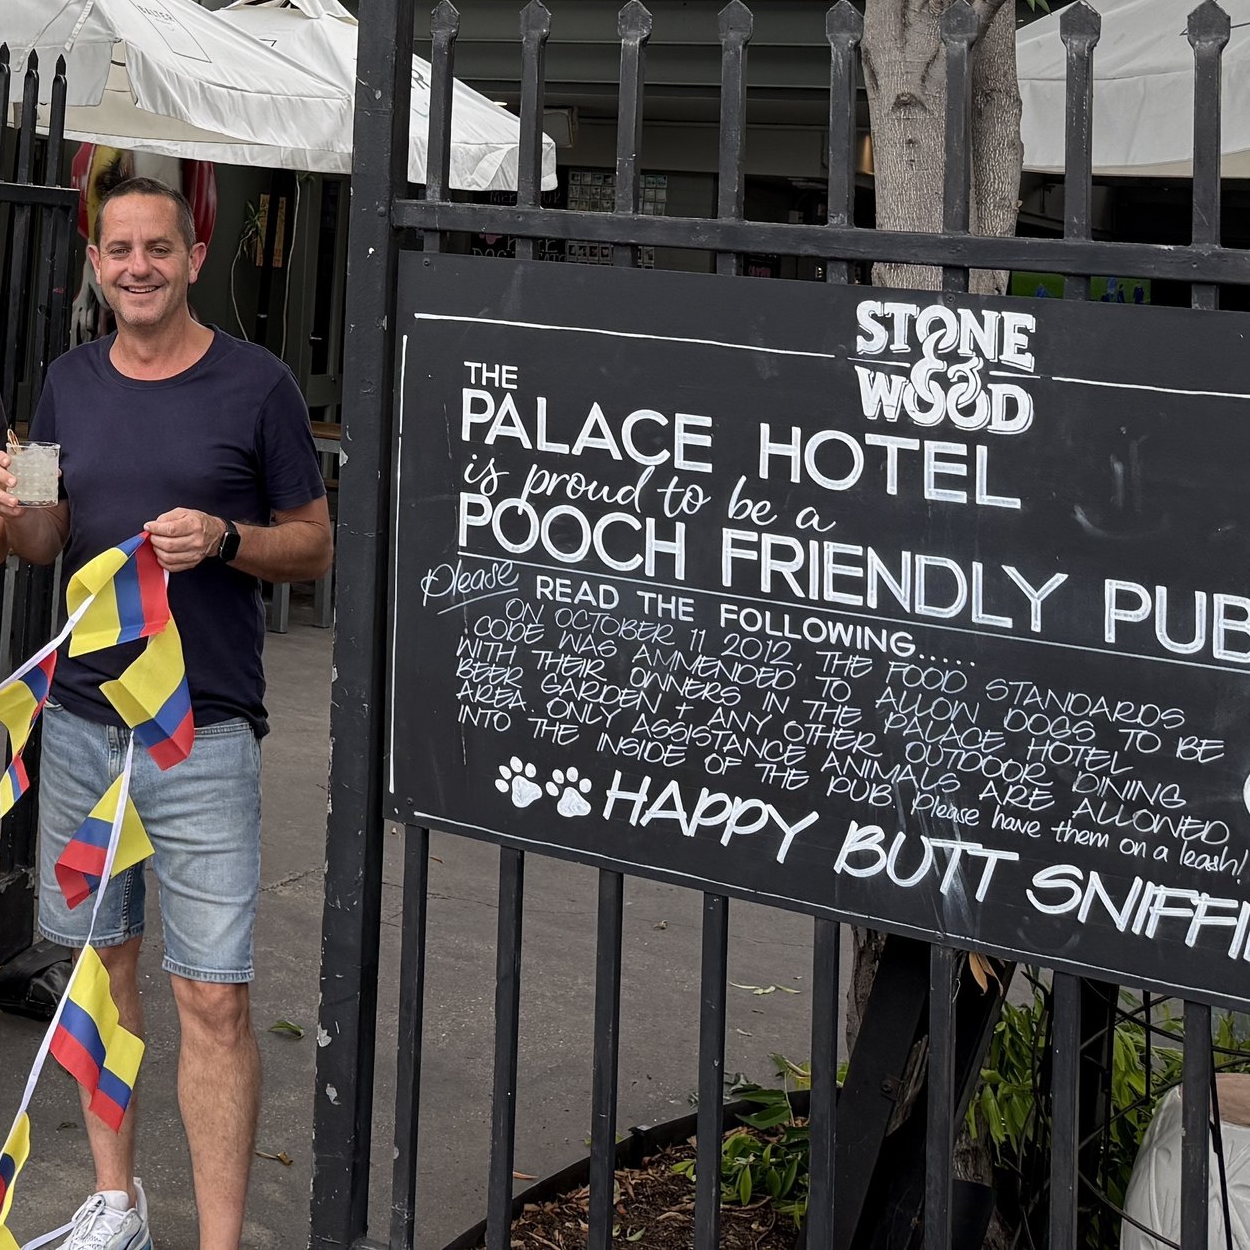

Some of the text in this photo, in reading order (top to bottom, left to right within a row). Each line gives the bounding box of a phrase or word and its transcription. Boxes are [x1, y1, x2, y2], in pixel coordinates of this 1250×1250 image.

[463, 360, 519, 390] THE
[854, 365, 1034, 435] WOOD
[856, 300, 1037, 373] STONE
[461, 387, 1022, 509] PALACE HOTEL
[463, 454, 837, 533] is proud to be a
[458, 491, 1250, 664] POOCH FRIENDLY PUB
[536, 575, 620, 609] READ
[637, 590, 695, 622] THE
[456, 636, 1134, 775] WITH THEIR OWNERS IN THE PALACE HOTEL
[473, 615, 1225, 763] CODE WAS AMMENDED TO ALLOW DOGS TO BE
[505, 598, 1185, 729] ON OCTOBER 11 2012, THE FOOD STANDARDS
[455, 657, 524, 688] BEER
[541, 673, 663, 714] GARDEN
[707, 706, 773, 735] ANY
[783, 720, 883, 757] OTHER
[905, 741, 1053, 786] OUTDOOR
[1072, 771, 1187, 808] DINING
[456, 680, 1230, 845] AREA. ONLY ASSISTANCE ANIMALS ARE ALLOWED
[458, 704, 511, 732] INTO
[527, 717, 580, 745] THE
[596, 733, 688, 767] INSIDE
[704, 753, 743, 776] OF
[754, 763, 810, 790] THE
[826, 775, 896, 809] PUB.
[991, 804, 1041, 838] have
[1051, 819, 1110, 849] them
[1119, 838, 1146, 859] on
[1153, 847, 1169, 863] a
[1179, 841, 1249, 885] leash!
[602, 769, 1250, 962] HAPPY BUTT SNIFFI
